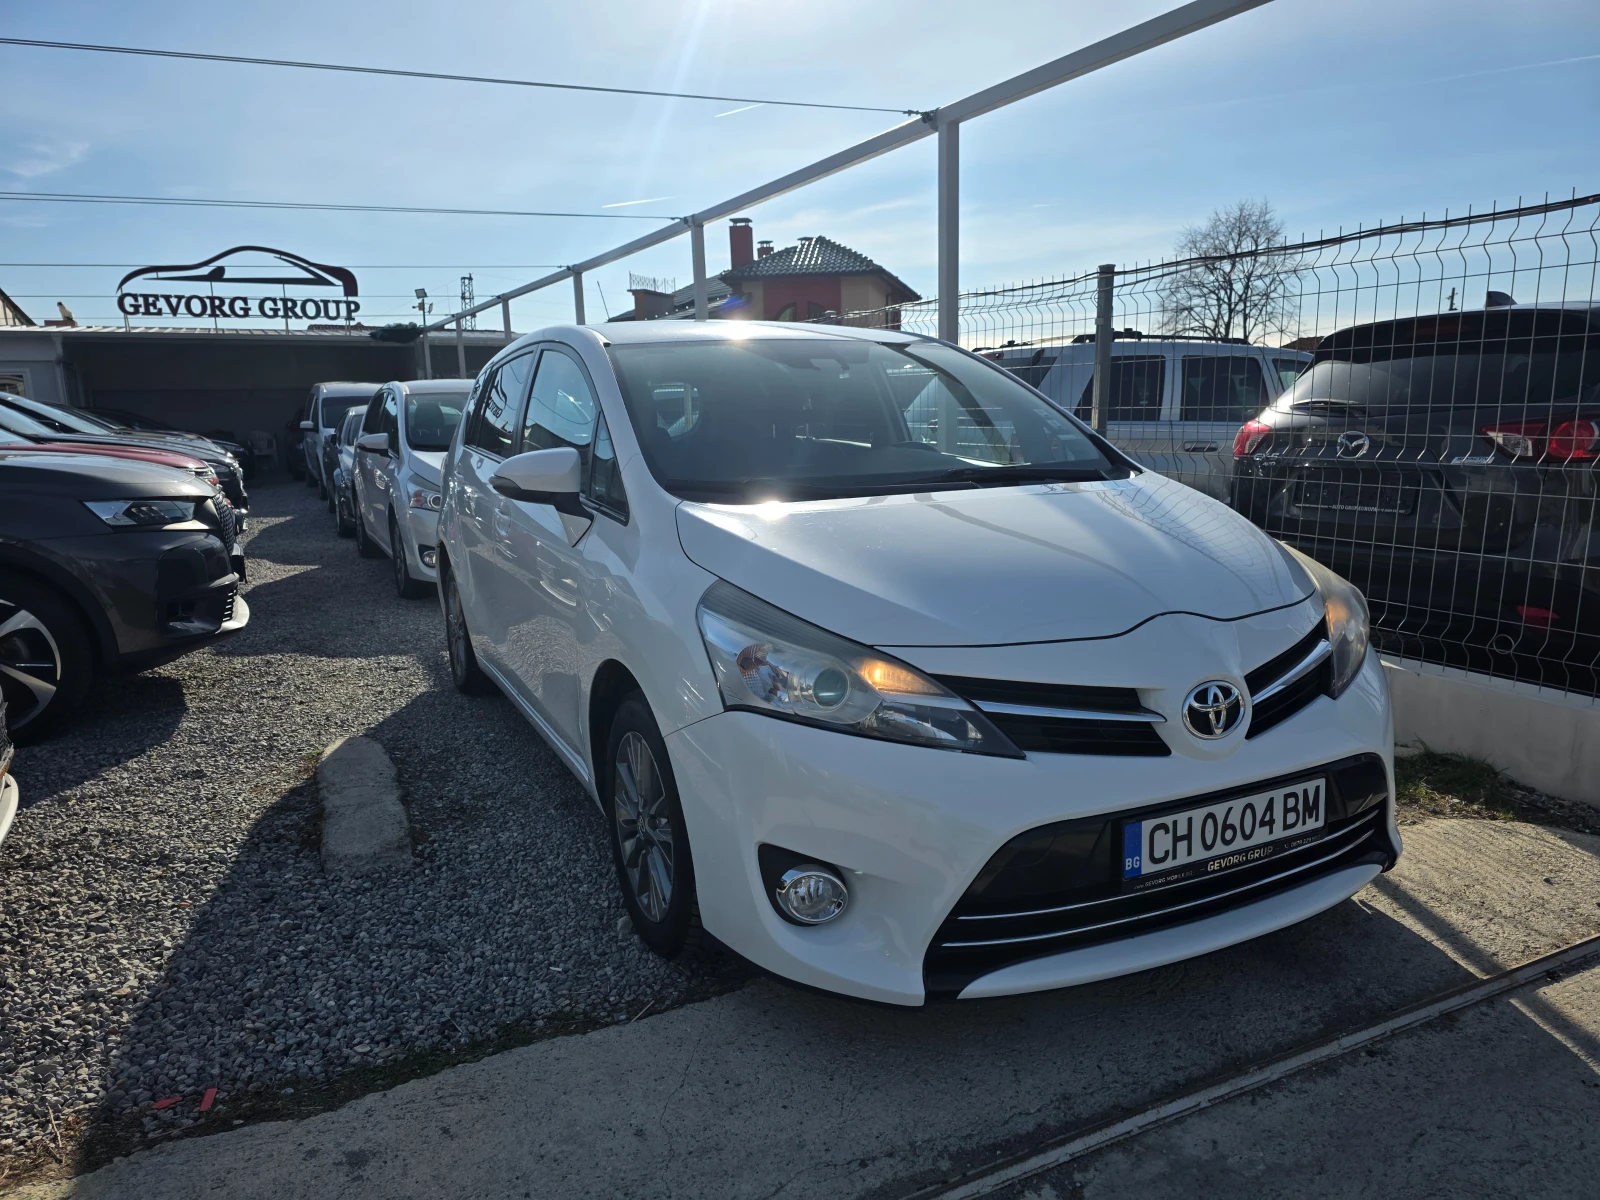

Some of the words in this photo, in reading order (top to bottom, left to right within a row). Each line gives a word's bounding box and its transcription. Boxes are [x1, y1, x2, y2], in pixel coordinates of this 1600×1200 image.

[117, 292, 252, 318] GEVORG
[258, 296, 361, 321] GROUP
[1125, 855, 1140, 870] BG
[1207, 852, 1247, 872] GEVORG
[1248, 845, 1274, 860] GRUP
